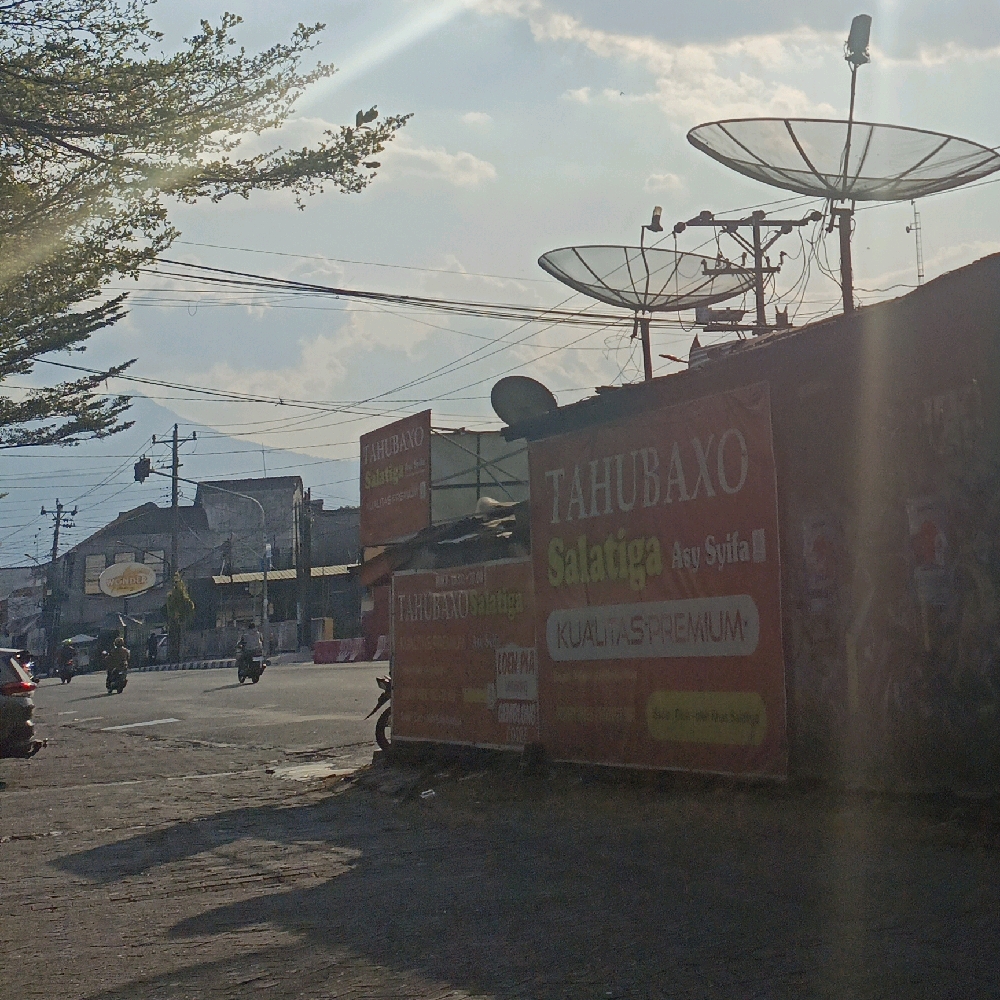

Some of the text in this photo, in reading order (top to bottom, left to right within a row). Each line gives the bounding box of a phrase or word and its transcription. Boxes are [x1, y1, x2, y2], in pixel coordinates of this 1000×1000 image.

[363, 426, 425, 465] TAHUBAXO
[364, 463, 404, 489] Salatiga
[545, 428, 749, 524] TAHUBAXO
[548, 527, 751, 591] Salatiga Asy Syifa
[398, 588, 524, 621] TAHUBAXO Salatiga
[556, 608, 745, 650] KUALITAS PREMIUM
